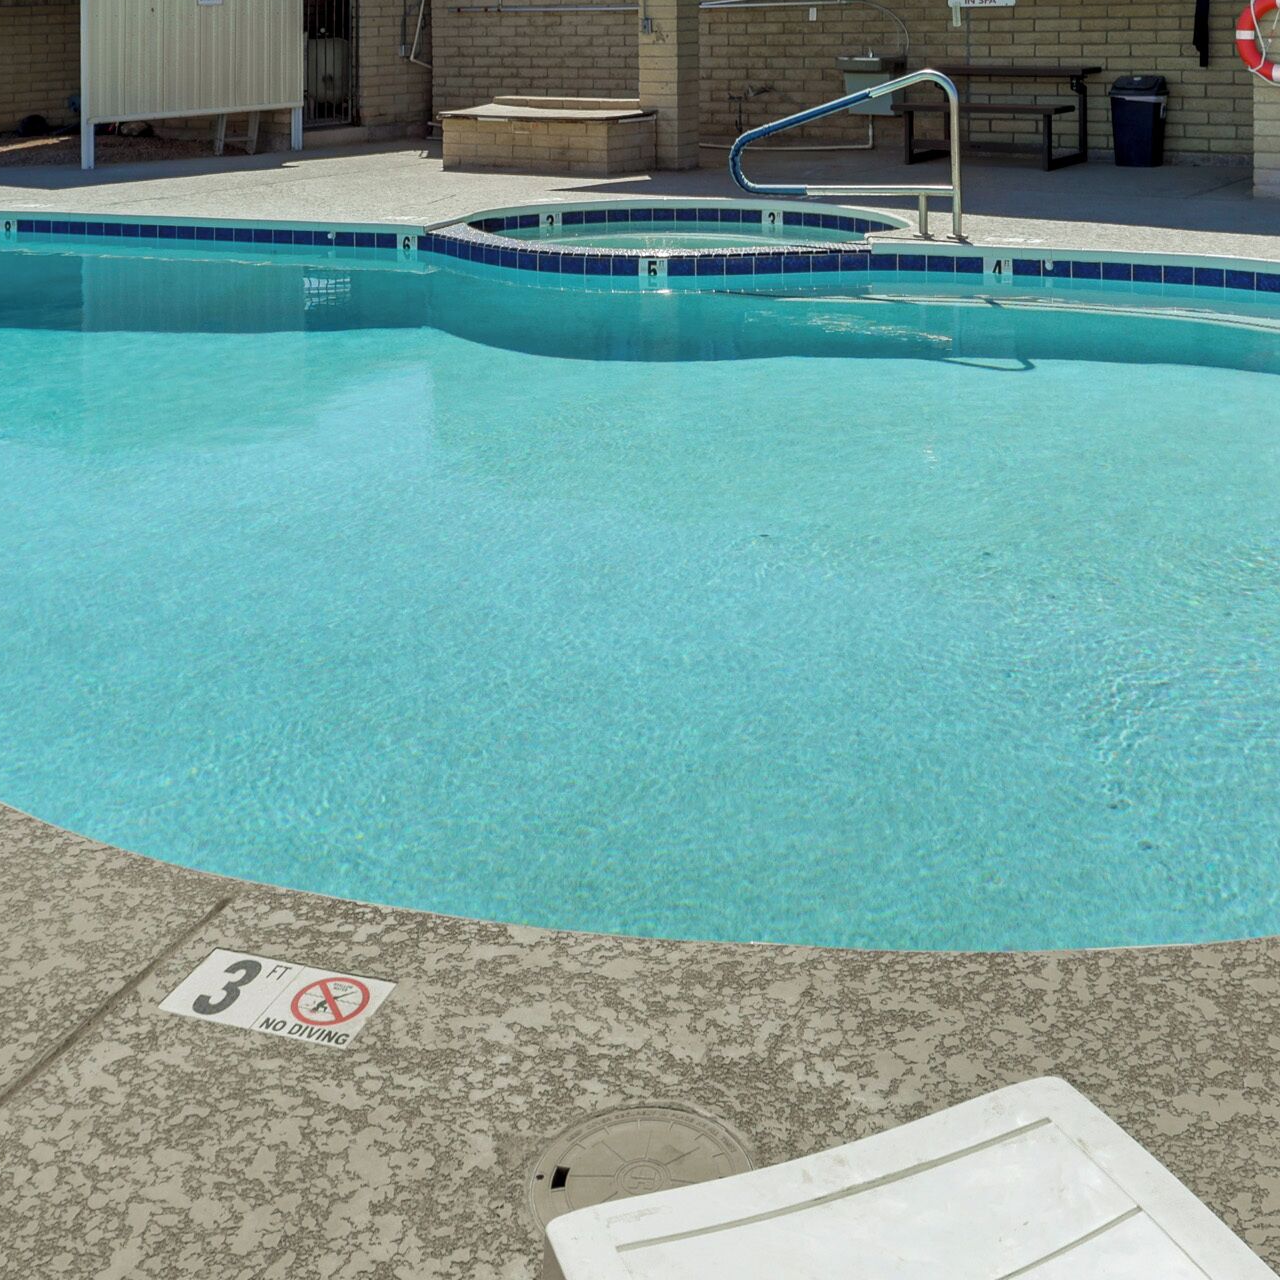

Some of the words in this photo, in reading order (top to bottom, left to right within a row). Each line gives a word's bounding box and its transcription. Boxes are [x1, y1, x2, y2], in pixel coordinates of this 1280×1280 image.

[192, 959, 263, 1016] 3
[266, 964, 293, 981] FT
[259, 1018, 288, 1032] NO
[288, 1022, 351, 1046] DIVING
